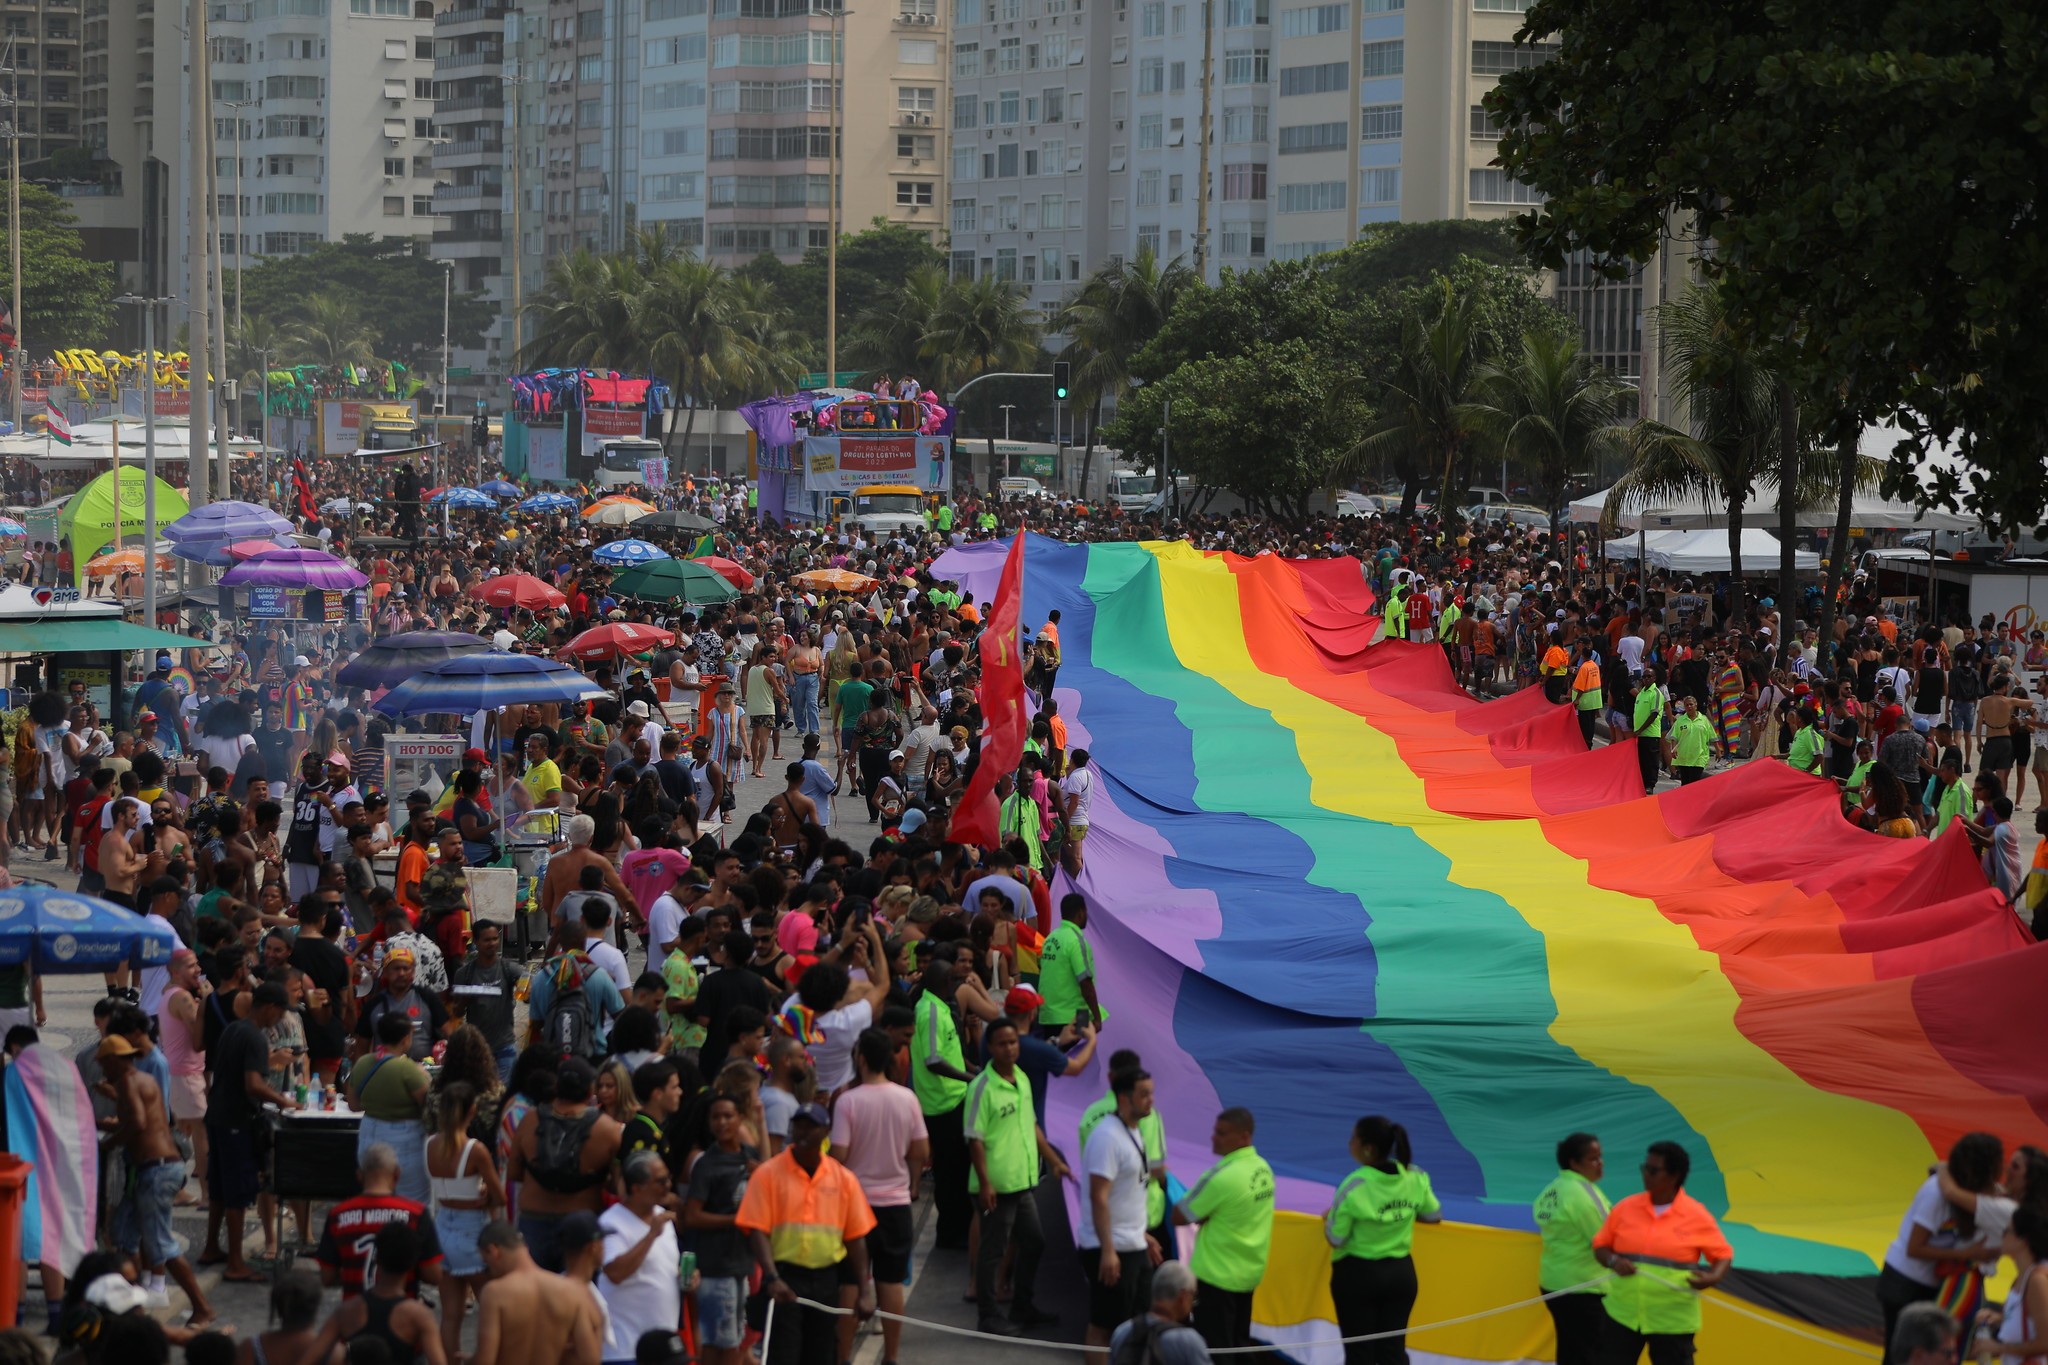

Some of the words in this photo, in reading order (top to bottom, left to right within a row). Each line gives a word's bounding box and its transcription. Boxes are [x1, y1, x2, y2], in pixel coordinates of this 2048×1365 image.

[400, 745, 425, 755] HOT
[428, 745, 454, 755] DOG
[296, 800, 316, 822] 36
[78, 942, 120, 952] nacional
[1000, 1103, 1016, 1118] 23
[354, 1234, 378, 1291] 7
